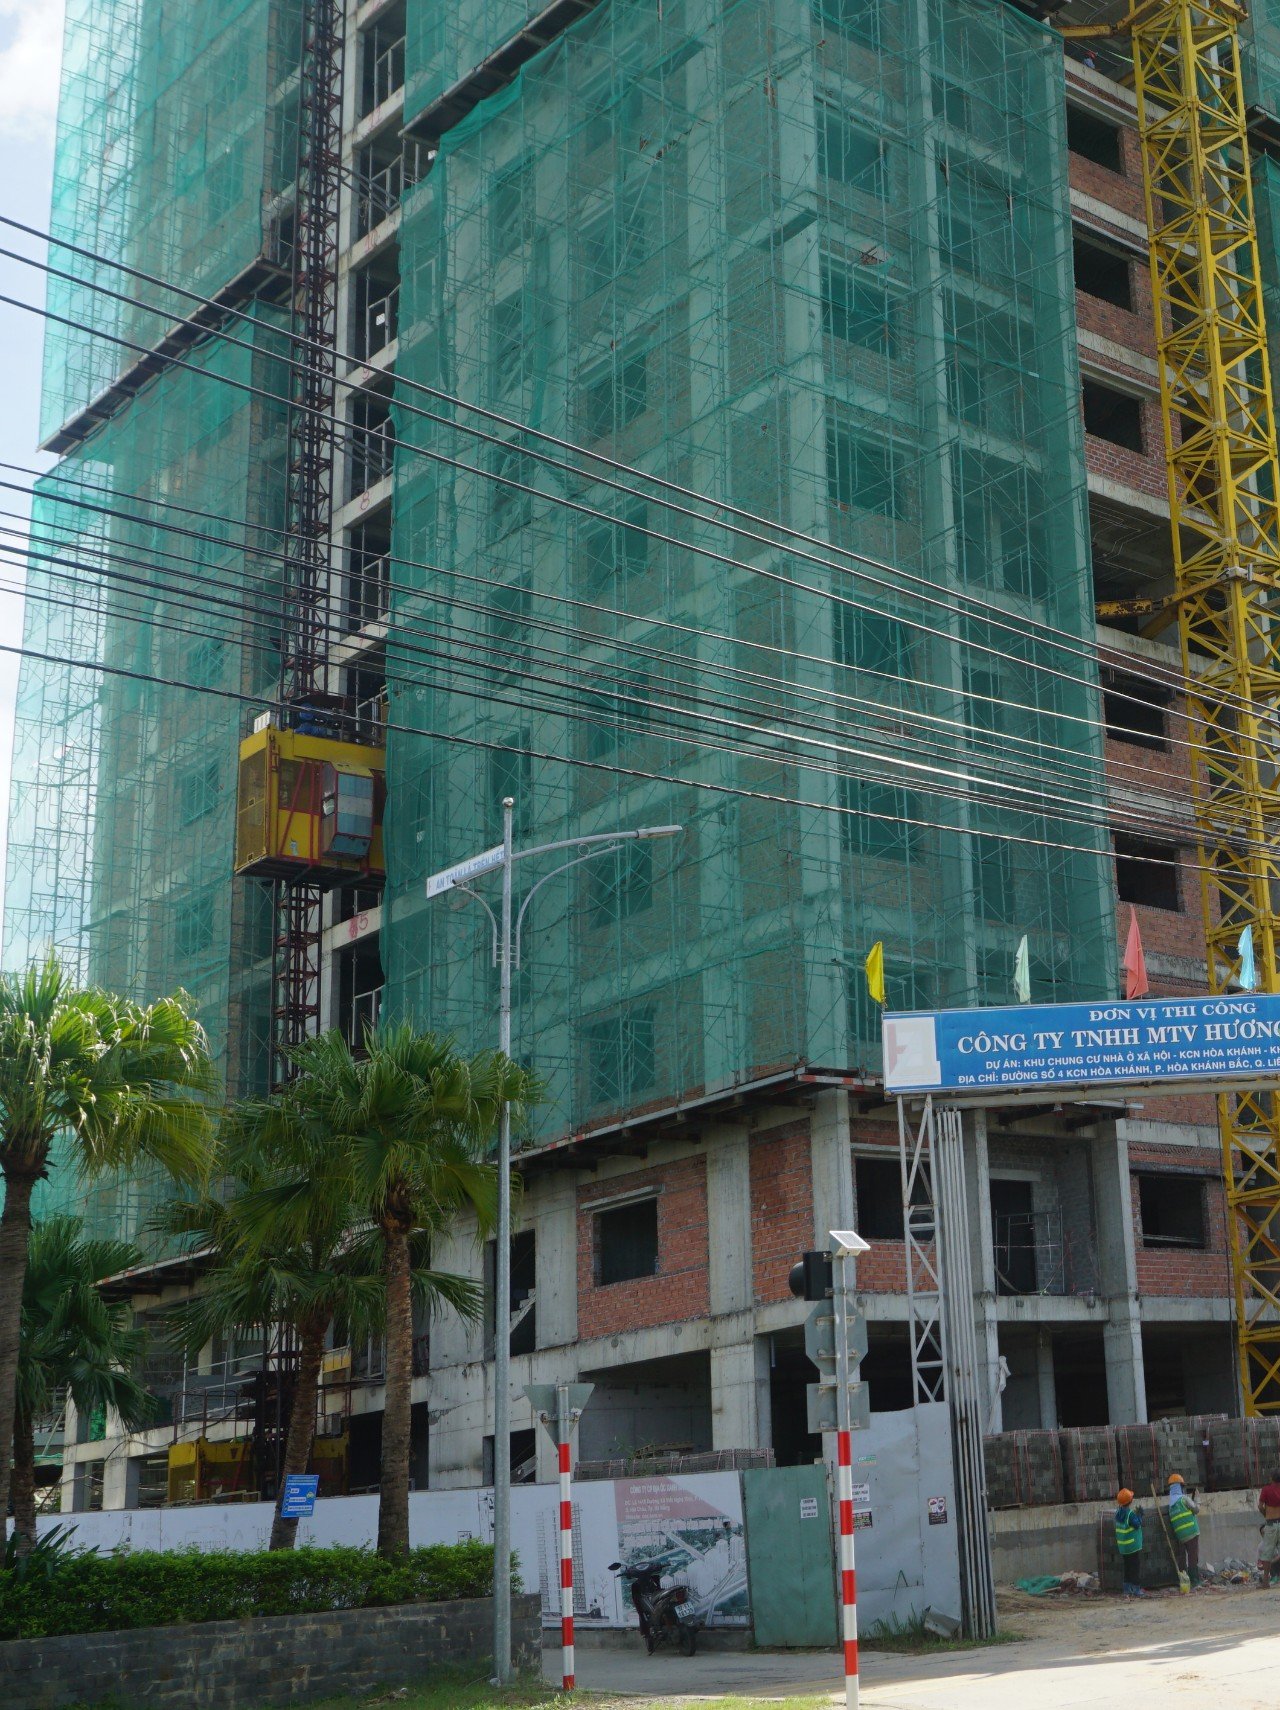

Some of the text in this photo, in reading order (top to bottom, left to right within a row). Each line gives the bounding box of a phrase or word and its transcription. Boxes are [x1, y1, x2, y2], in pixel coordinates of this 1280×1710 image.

[1089, 1001, 1257, 1022] ĐƠN VỊ THI CÔNG
[957, 1030, 1028, 1054] CÔNG
[1033, 1031, 1065, 1050] TY
[1071, 1027, 1140, 1048] TNHH
[1147, 1025, 1199, 1044] MTV
[958, 1074, 976, 1085] ĐỊA
[1001, 1069, 1039, 1081] ĐƯỜNG
[1041, 1065, 1056, 1079] SỐ
[1057, 1068, 1065, 1079] 4
[1066, 1067, 1088, 1078] KCN
[1090, 1065, 1112, 1076] HÒA
[1114, 1064, 1153, 1075] KHÁNH,
[1155, 1063, 1165, 1074] P.
[1167, 1061, 1189, 1073] HÒA
[1190, 1059, 1227, 1071] KHÁNH
[1228, 1055, 1253, 1070] BẮC,
[1255, 1058, 1265, 1069] Q.
[985, 1059, 1001, 1070] DỰ
[1003, 1057, 1021, 1069] ÁN:
[1023, 1057, 1045, 1068] KHU
[1047, 1055, 1084, 1066] CHUNG
[1086, 1053, 1101, 1064] CƯ
[1103, 1052, 1124, 1063] NHÀ
[1127, 1051, 1135, 1062] Ở
[1137, 1050, 1151, 1062] XÃ
[1153, 1050, 1171, 1061] HỘI
[1179, 1049, 1201, 1060] KCN
[1203, 1047, 1225, 1059] HÒA
[1226, 1046, 1262, 1057] KHÁNH
